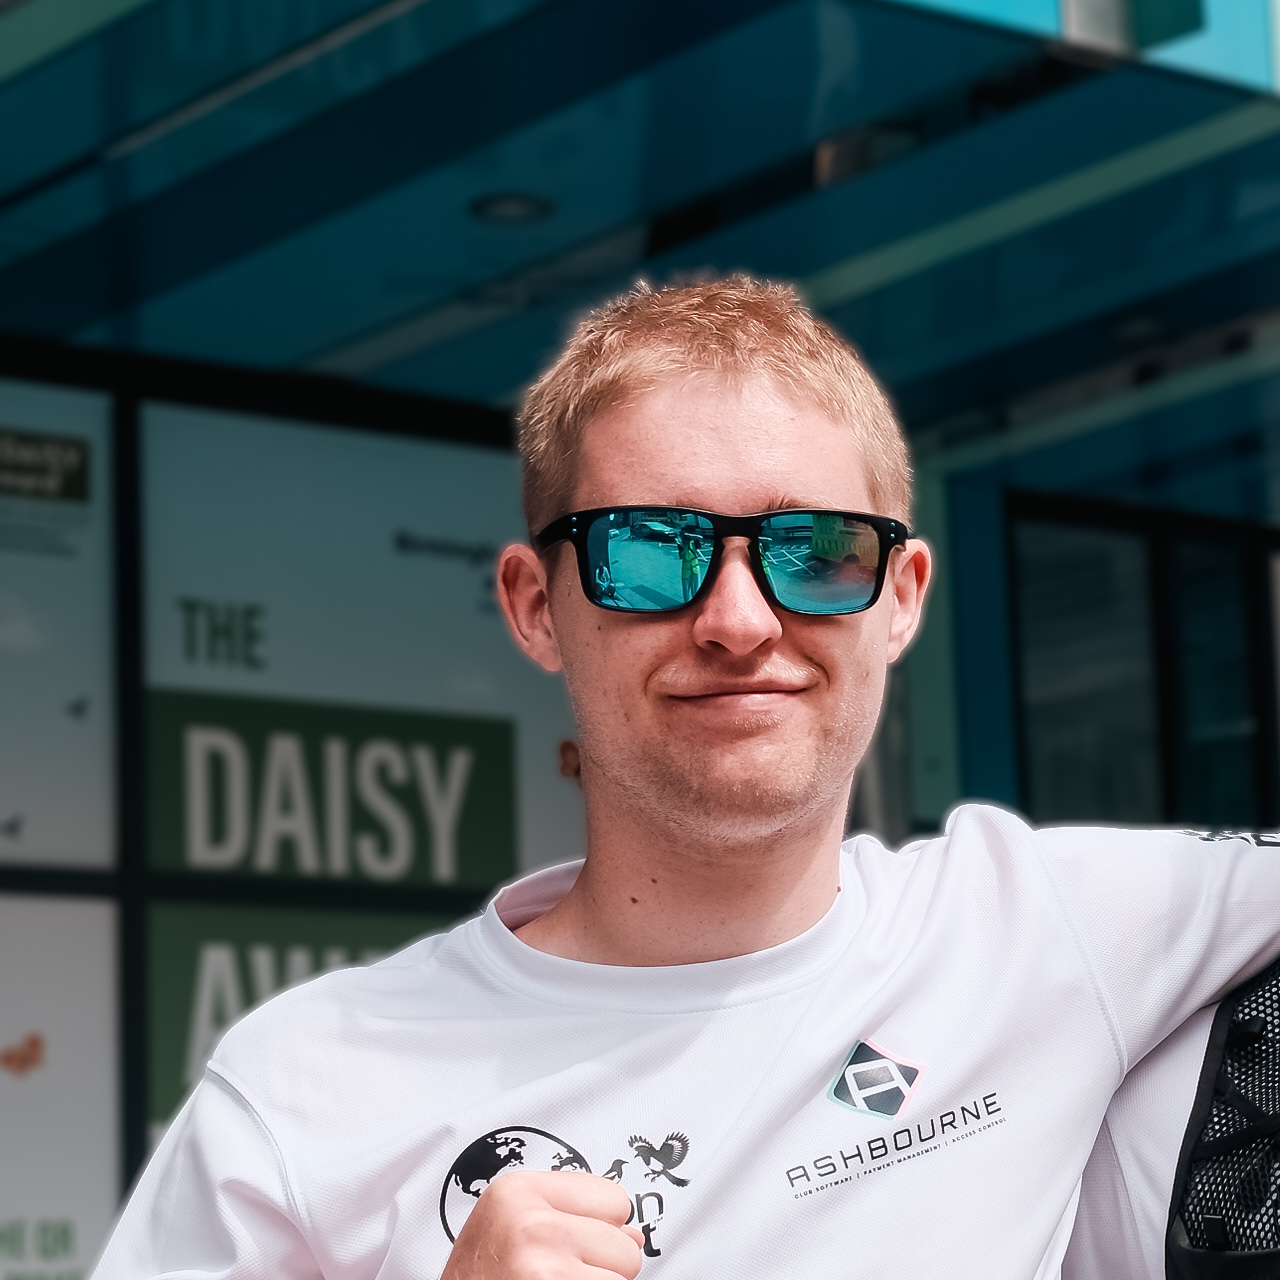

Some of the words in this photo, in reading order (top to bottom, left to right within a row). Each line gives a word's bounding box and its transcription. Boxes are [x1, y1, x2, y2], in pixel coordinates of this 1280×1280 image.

[176, 596, 268, 671] THE
[185, 726, 473, 883] DAISY
[786, 1092, 1002, 1188] ASHBOURNE
[795, 1189, 813, 1199] CLUB
[815, 1176, 852, 1192] SOFTWARE
[863, 1160, 895, 1175] PAYMENT
[897, 1144, 941, 1163] MANAGEMENT
[952, 1130, 976, 1143] ACCESS
[978, 1117, 1007, 1132] CONTROL
